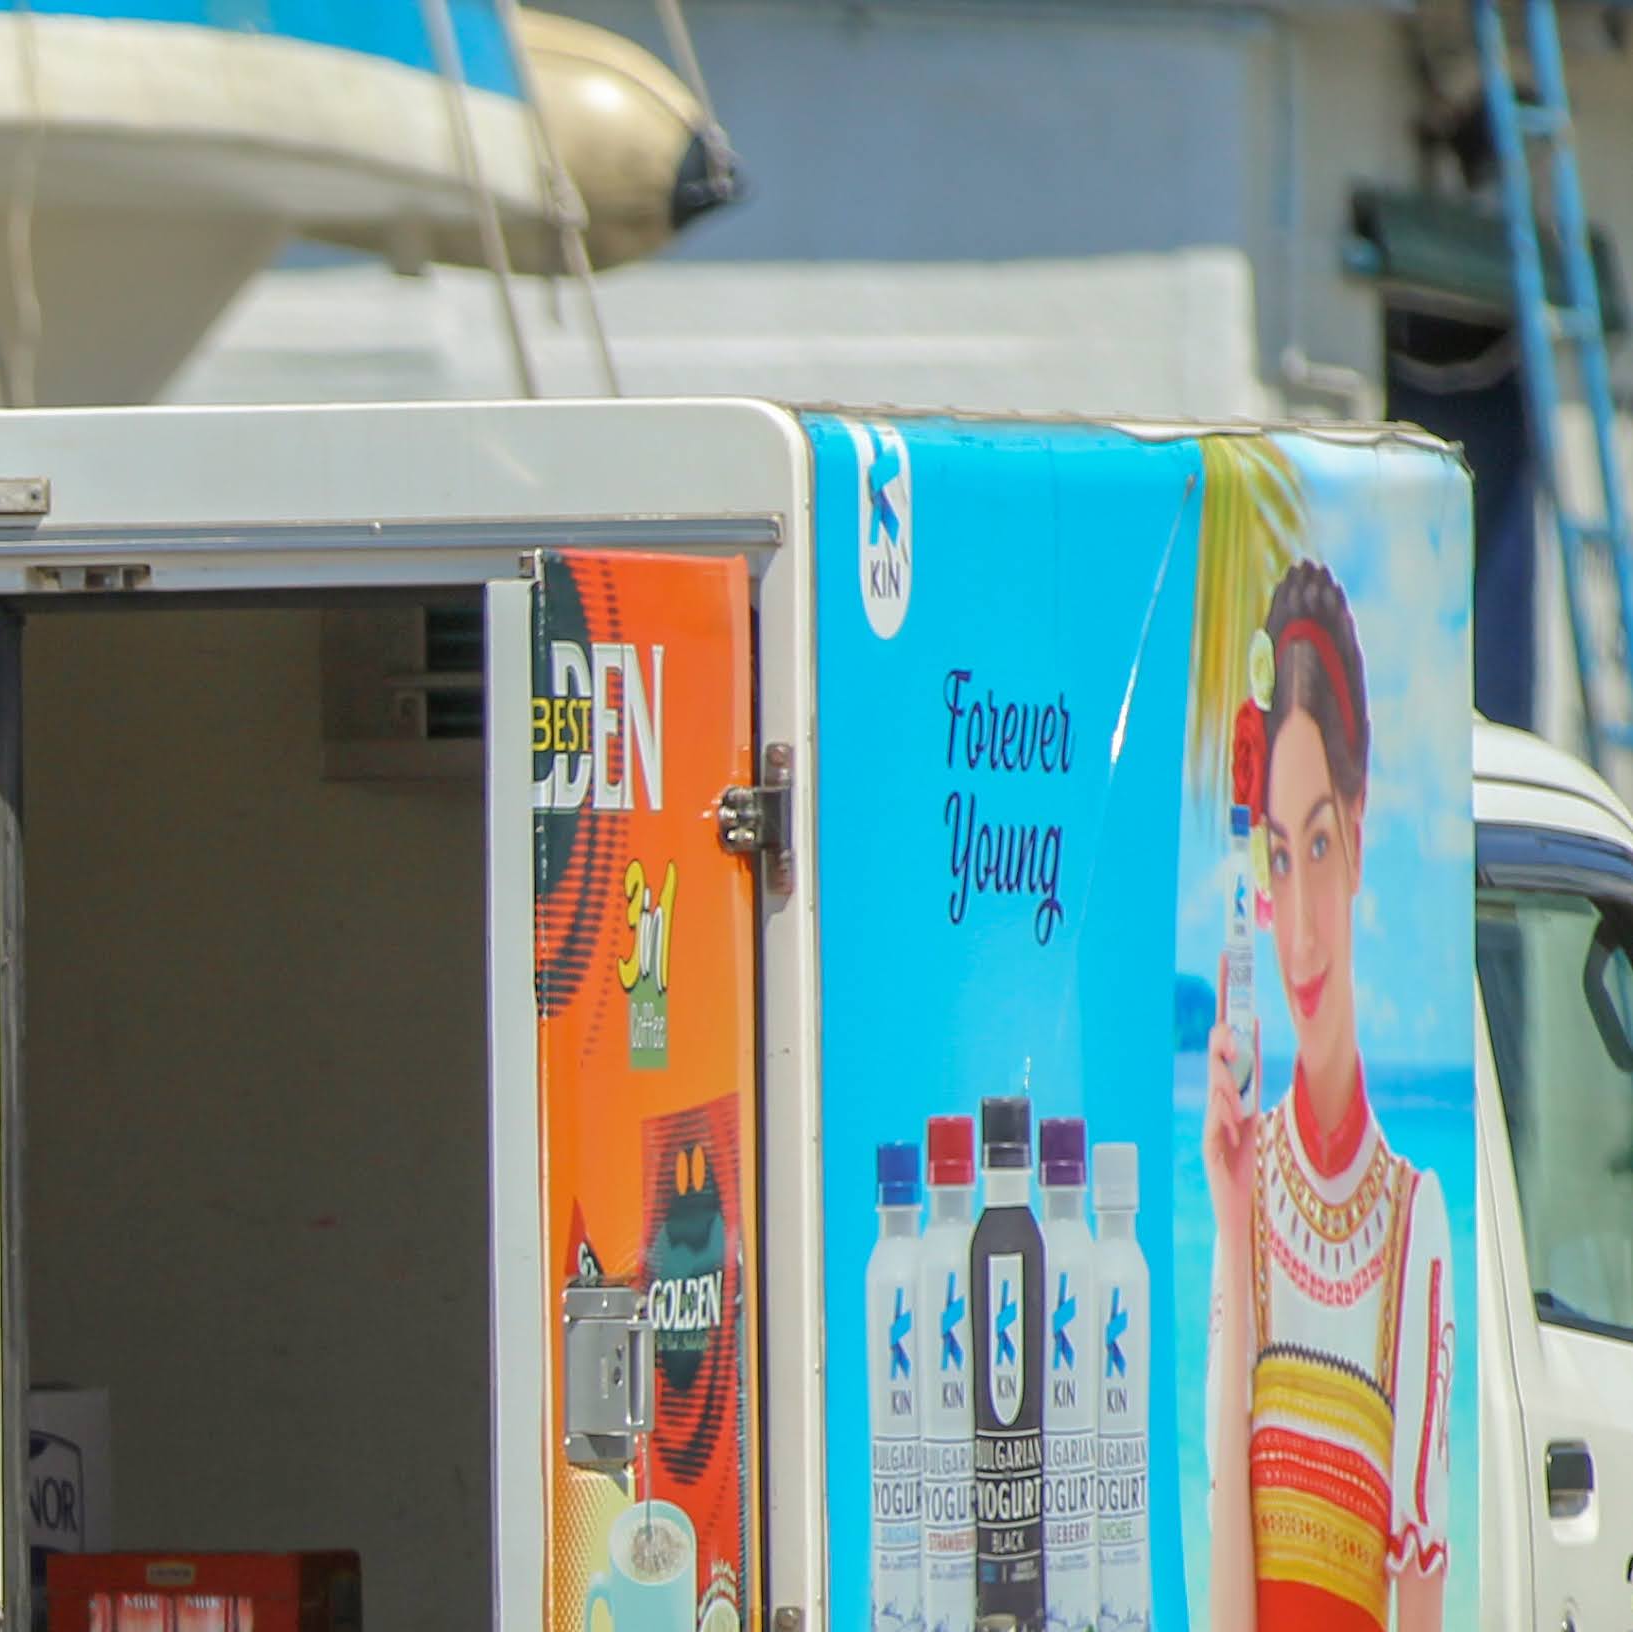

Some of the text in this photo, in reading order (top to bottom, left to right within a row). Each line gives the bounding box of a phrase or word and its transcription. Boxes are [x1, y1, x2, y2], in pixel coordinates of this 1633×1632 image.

[869, 559, 901, 600] KIN
[531, 697, 592, 751] BEST
[943, 669, 1073, 774] Forever
[943, 791, 1064, 946] Young
[646, 1269, 724, 1332] GOLDEN
[890, 1389, 913, 1416] KIN
[942, 1382, 966, 1410] KIN
[996, 1374, 1018, 1400] KIN
[1053, 1380, 1077, 1408] KIN
[1106, 1388, 1129, 1414] KIN
